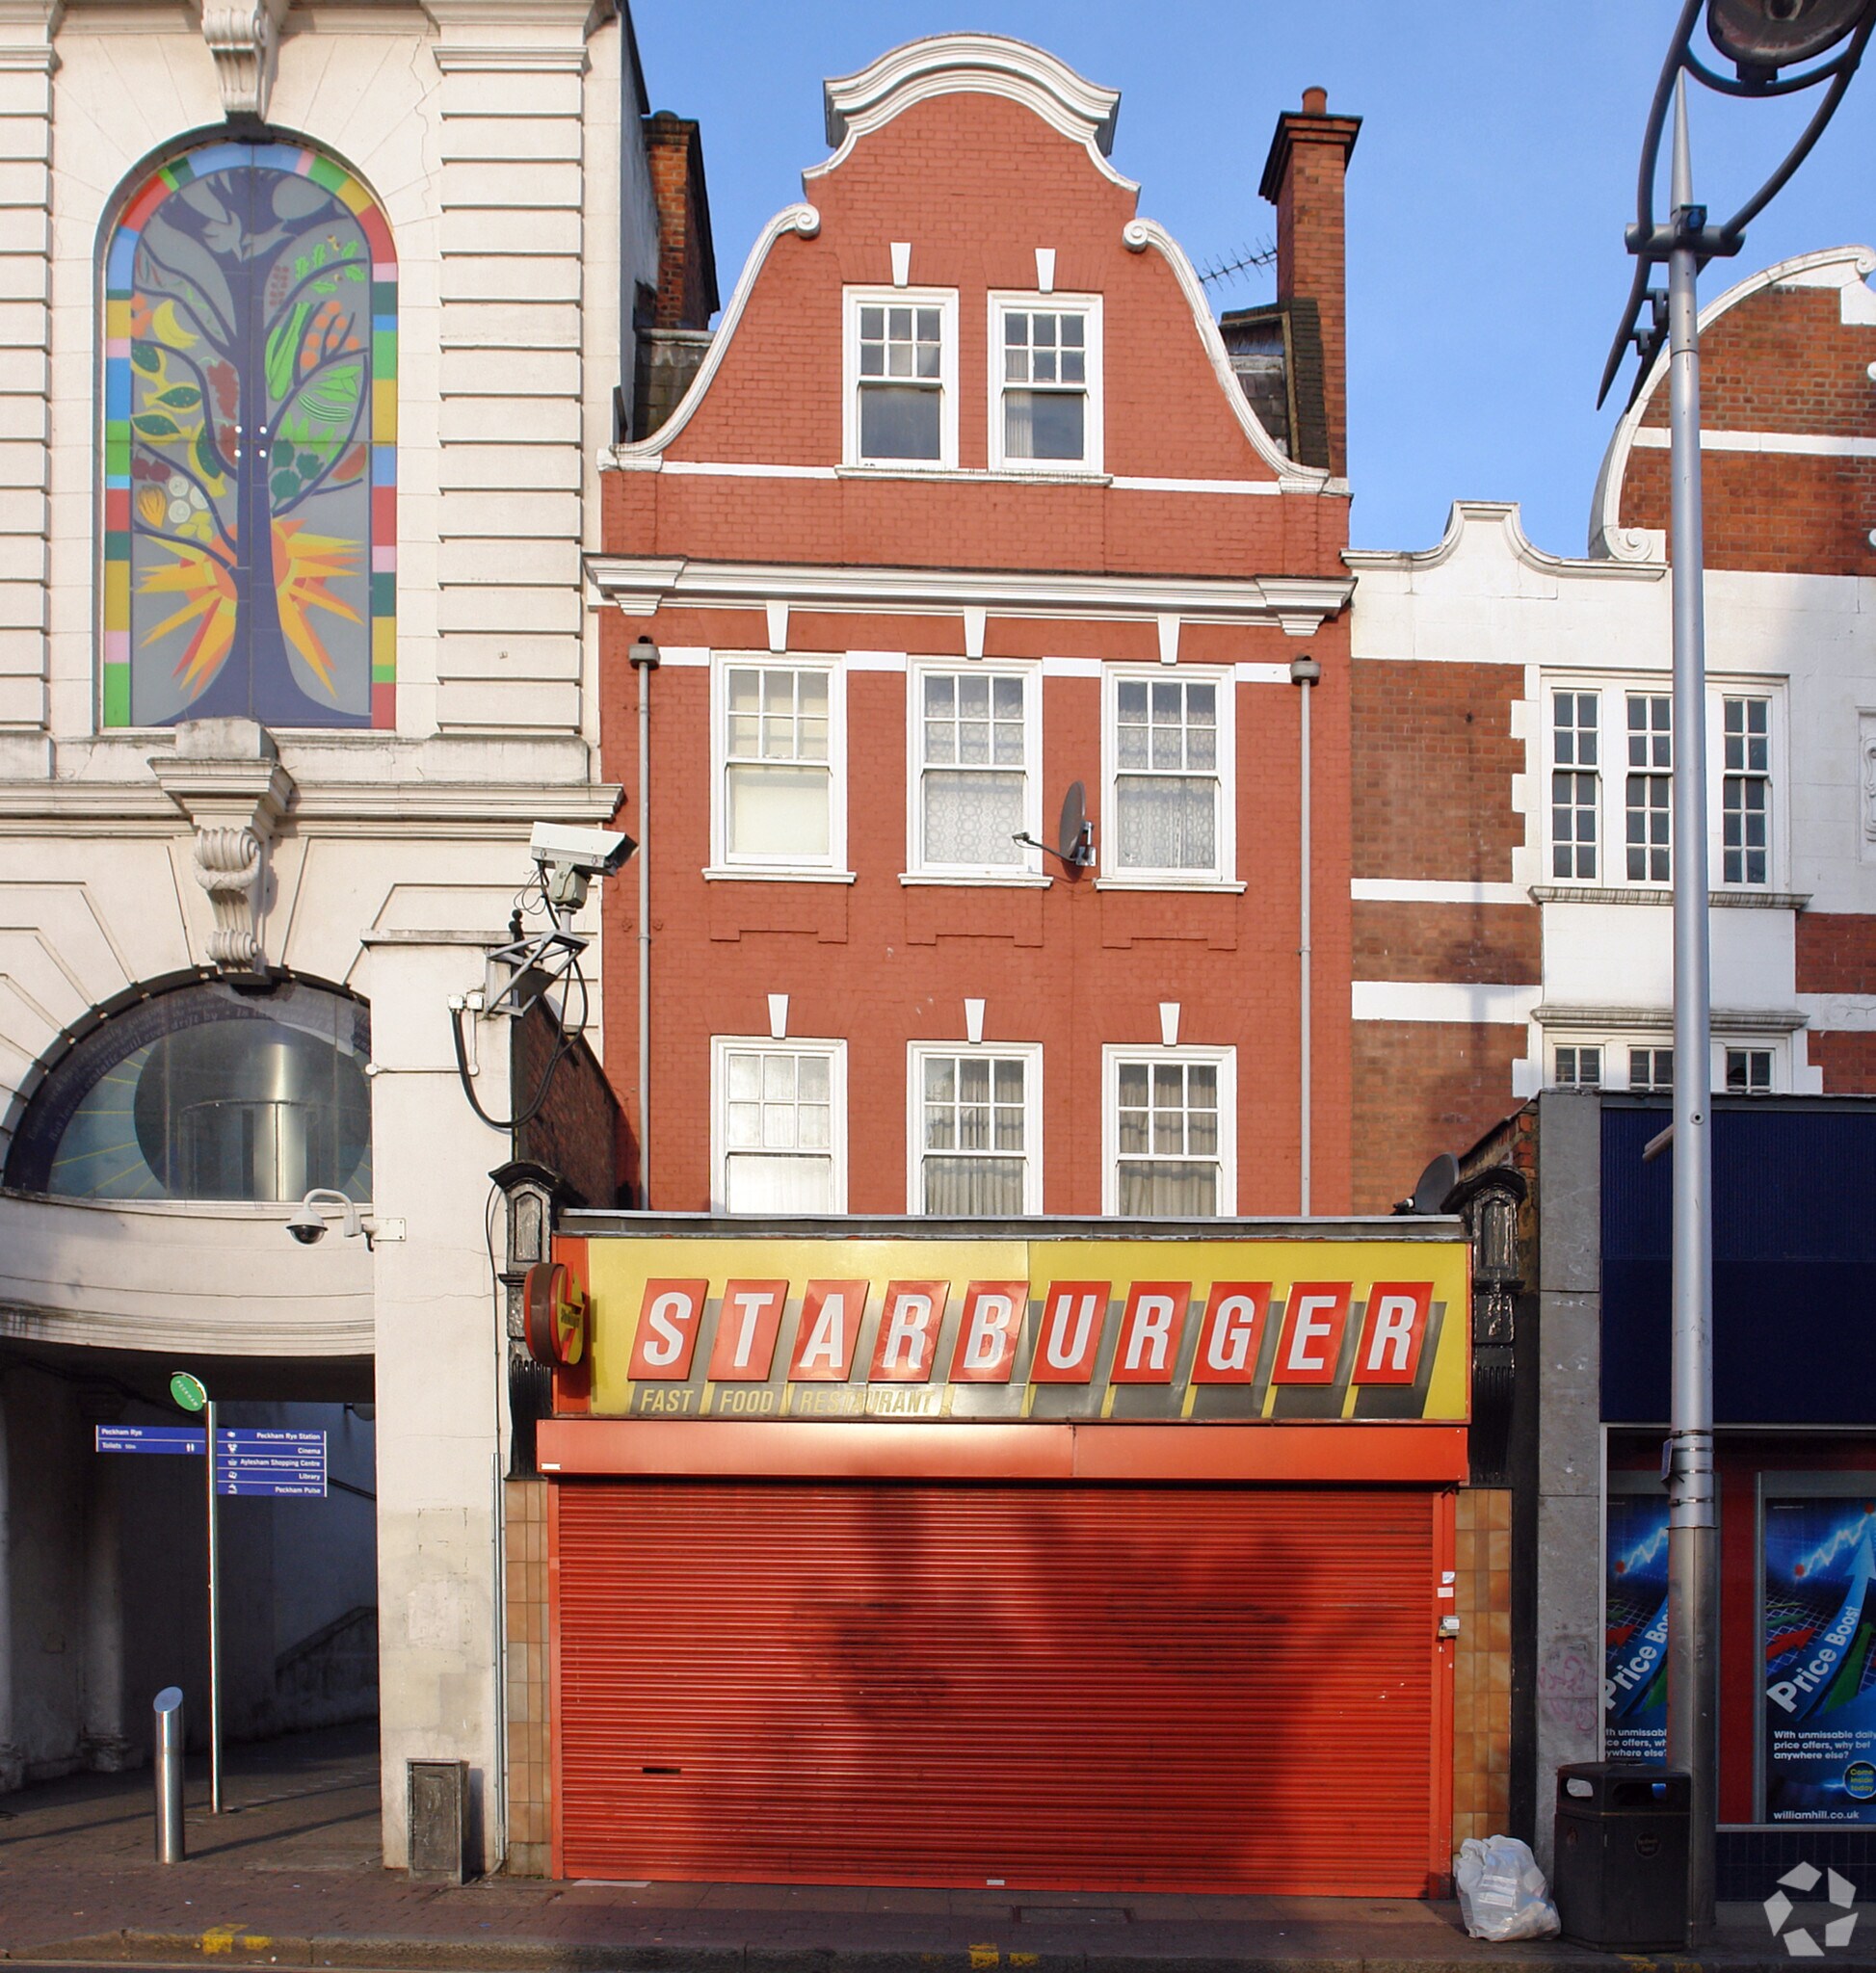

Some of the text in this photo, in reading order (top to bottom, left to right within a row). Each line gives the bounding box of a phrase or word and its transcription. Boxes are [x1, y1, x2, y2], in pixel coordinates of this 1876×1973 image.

[643, 1291, 1417, 1371] STARBURGER
[175, 1380, 199, 1407] PECKHAM
[639, 1388, 936, 1415] FAST FOOD RESTAURANT
[101, 1428, 143, 1437] Peckham Rye
[256, 1432, 284, 1440] Peckham
[285, 1433, 298, 1441] Rye
[102, 1441, 122, 1450] Toilets
[275, 1486, 304, 1494] Peckham
[1766, 1605, 1861, 1714] Price Boost
[1618, 1728, 1668, 1737] unmissabl
[1774, 1730, 1796, 1739] With
[1798, 1730, 1853, 1739] unmissable
[1622, 1738, 1651, 1748] offers,
[1774, 1742, 1800, 1750] price
[1802, 1741, 1833, 1750] offers,
[1835, 1741, 1854, 1750] why
[1606, 1749, 1642, 1758] ywhere
[1774, 1751, 1823, 1760] anywhere
[1773, 1810, 1860, 1820] williamhill.co.uk
